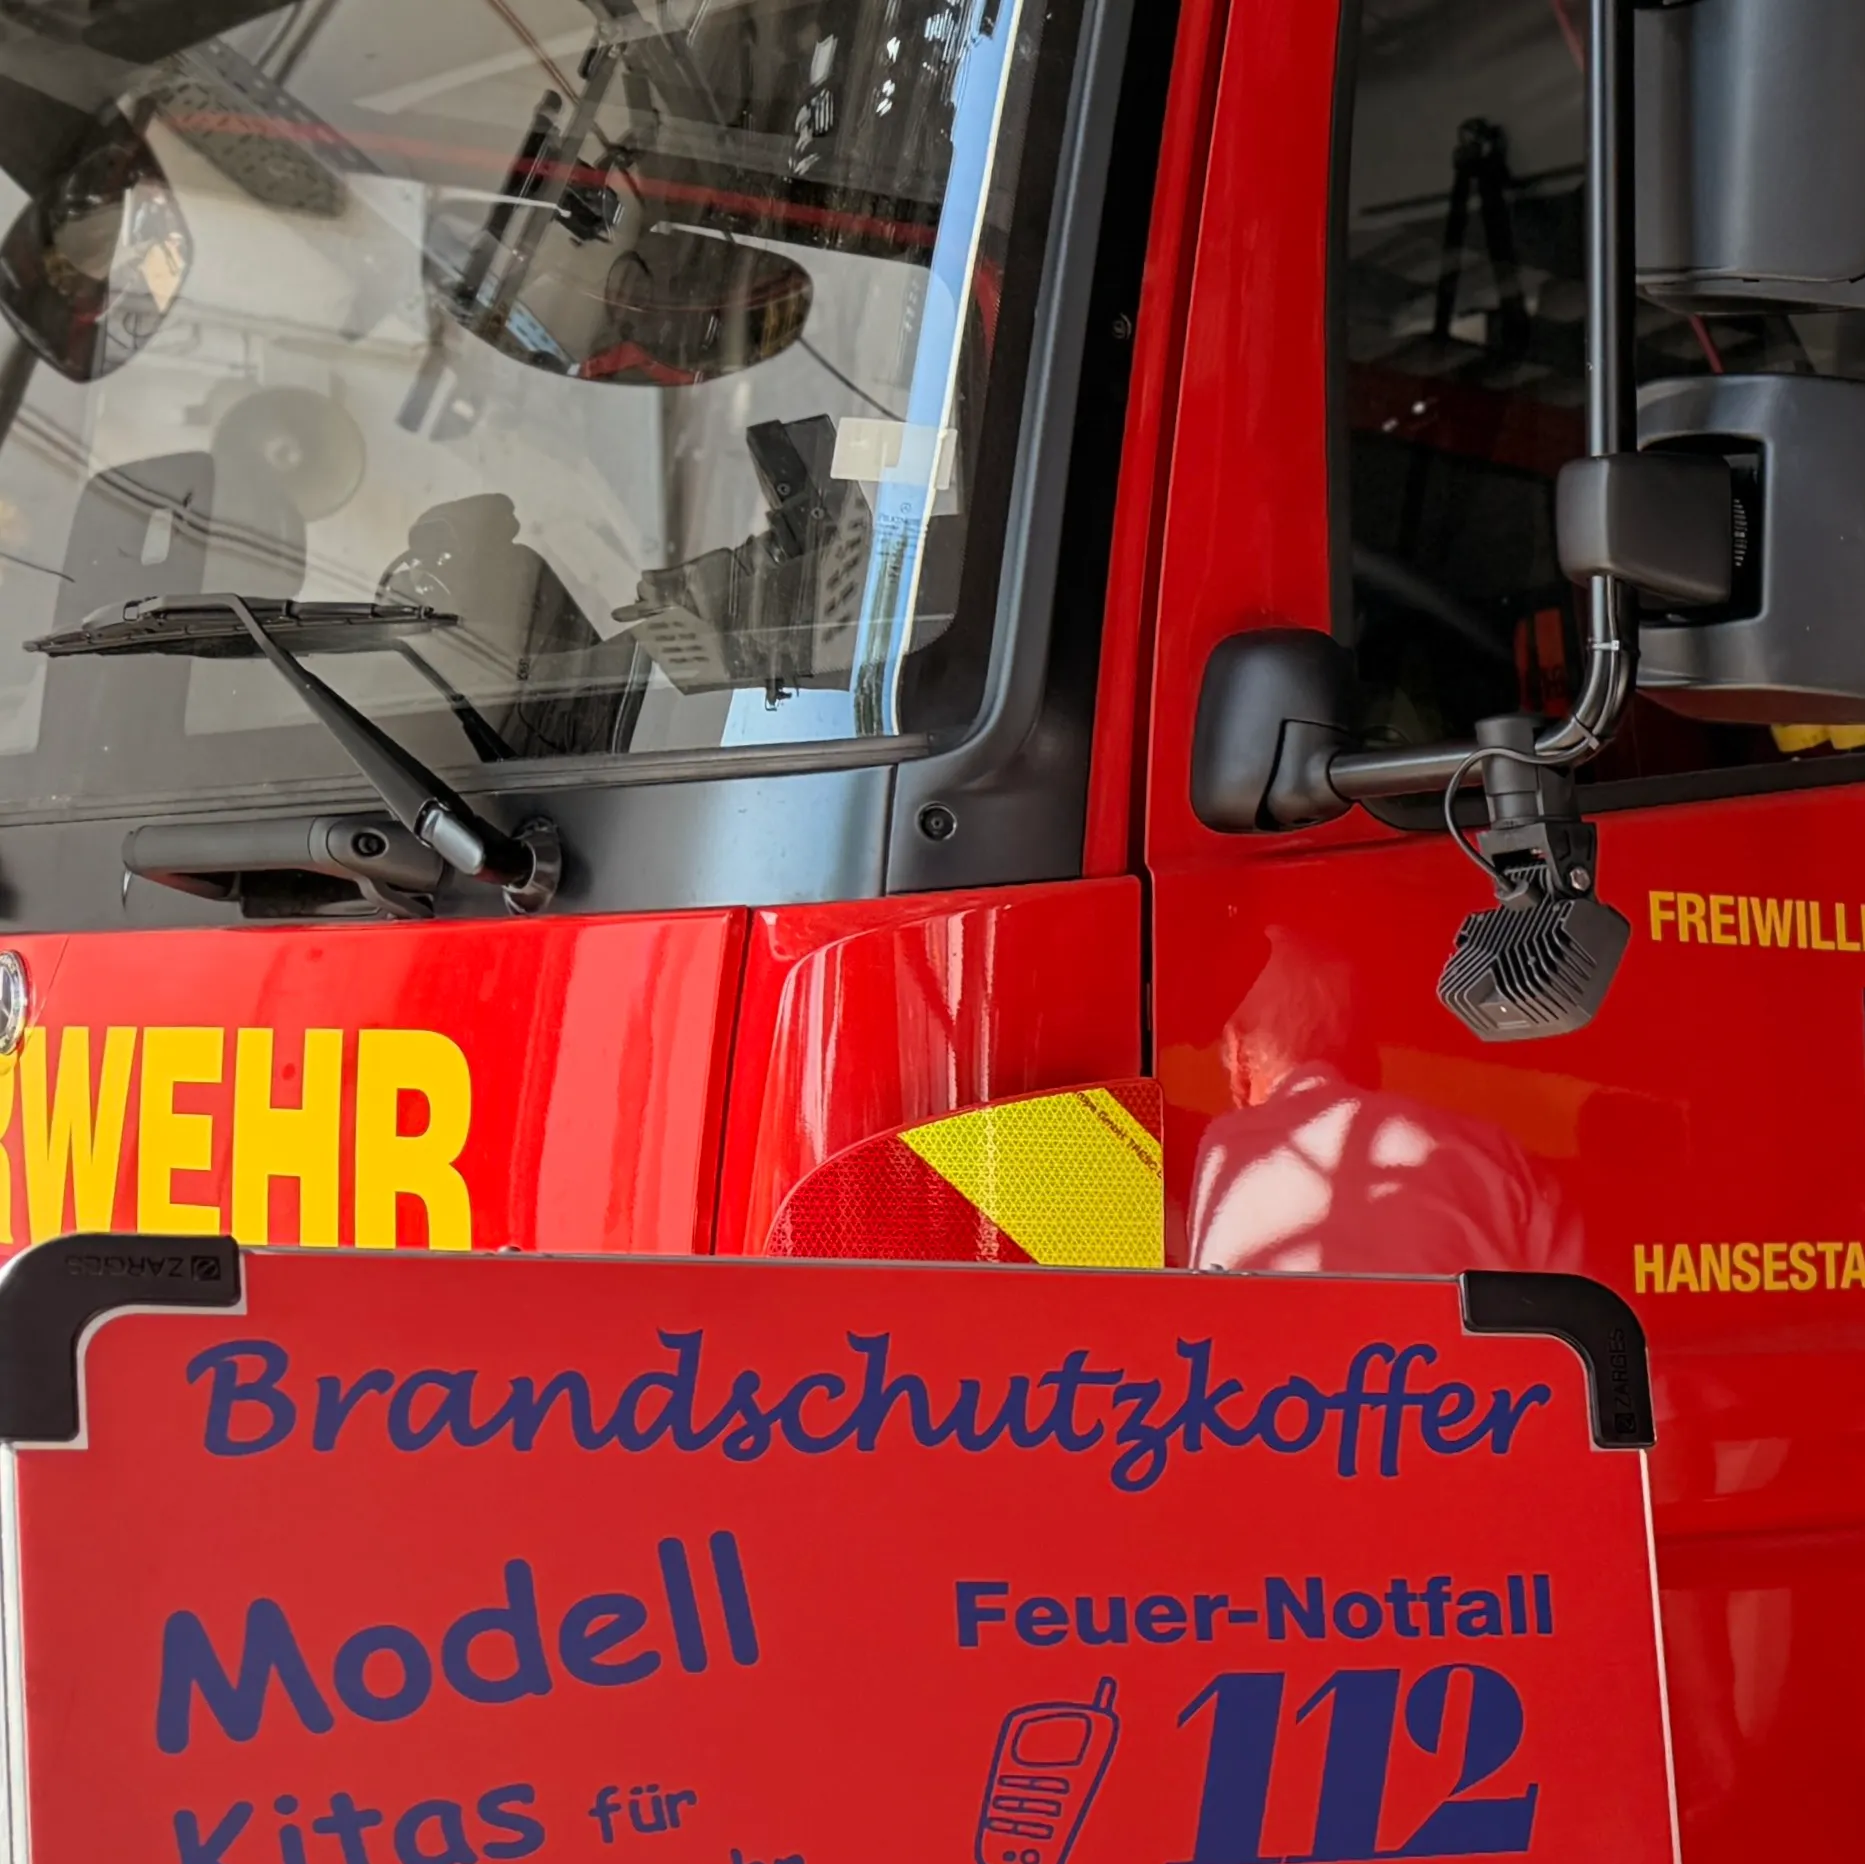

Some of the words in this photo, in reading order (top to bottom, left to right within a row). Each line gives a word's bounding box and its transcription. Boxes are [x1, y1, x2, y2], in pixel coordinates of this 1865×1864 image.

[0, 1026, 472, 1250] WEHR
[186, 1327, 1552, 1492] Brandschutzkoffer
[156, 1530, 760, 1754] Modell
[954, 1573, 1554, 1648] Feuer-Notfall
[588, 1784, 698, 1844] für
